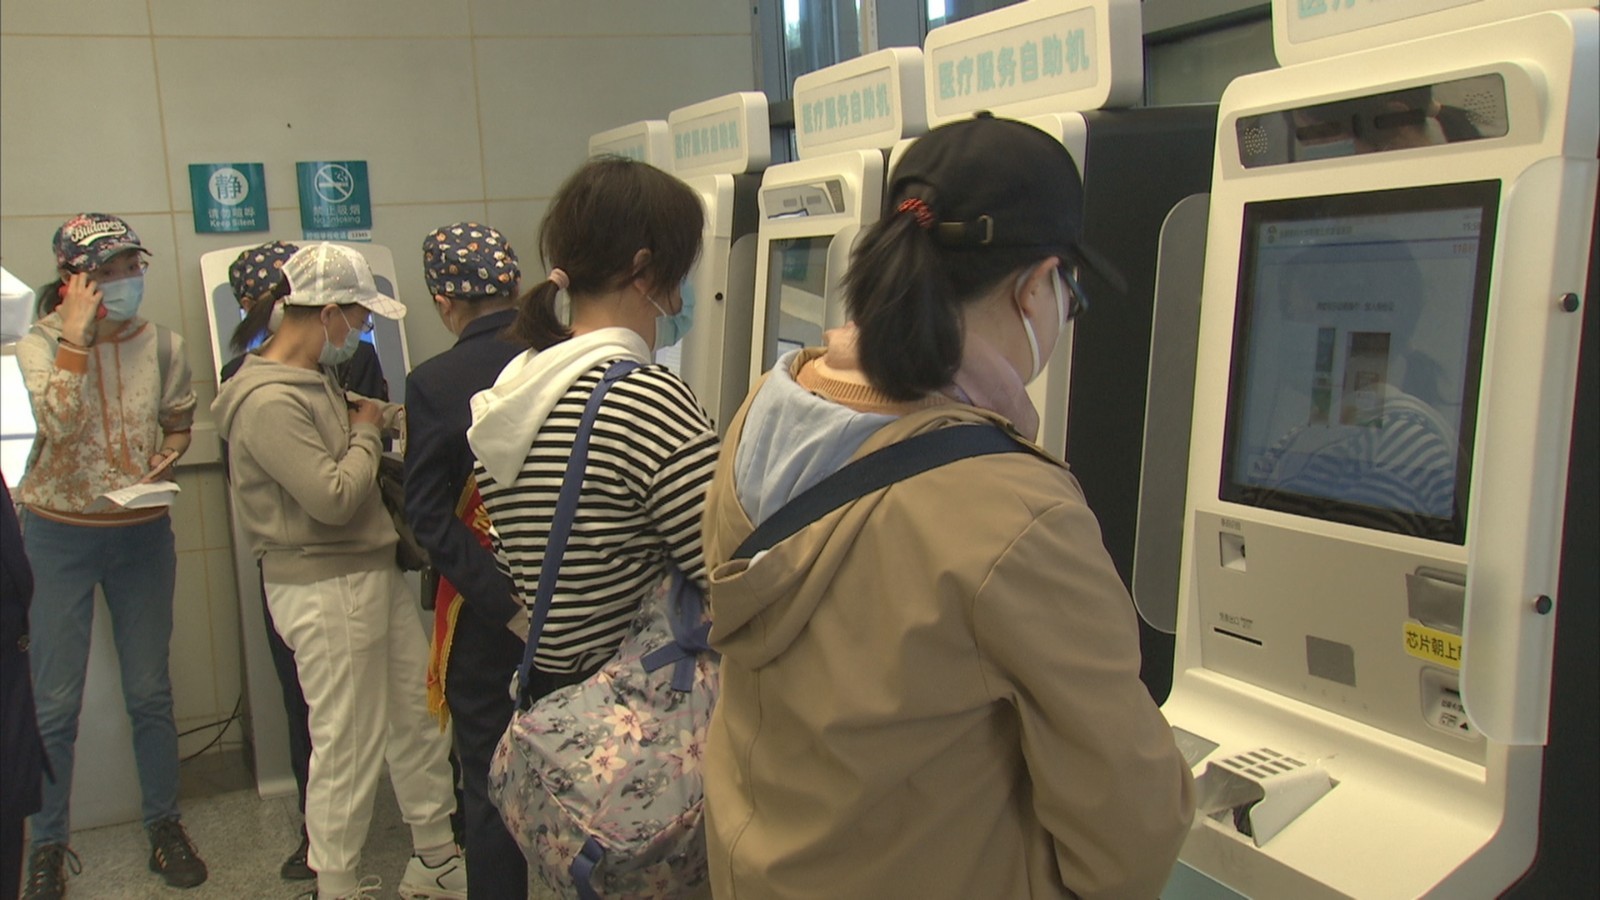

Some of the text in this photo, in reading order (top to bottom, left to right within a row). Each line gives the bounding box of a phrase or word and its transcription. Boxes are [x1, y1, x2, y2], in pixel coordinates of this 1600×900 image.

[938, 28, 1090, 100] 医疗服务自助机
[802, 82, 890, 134] 医疗服务自助机
[215, 174, 242, 199] 静
[208, 206, 256, 219] 请勿喧哗
[210, 218, 256, 228] Keep Silent
[313, 204, 361, 218] 禁止吸烟
[313, 214, 361, 224] No Smoking
[70, 219, 125, 243] Budapest
[1406, 630, 1462, 661] 芯片朝上
